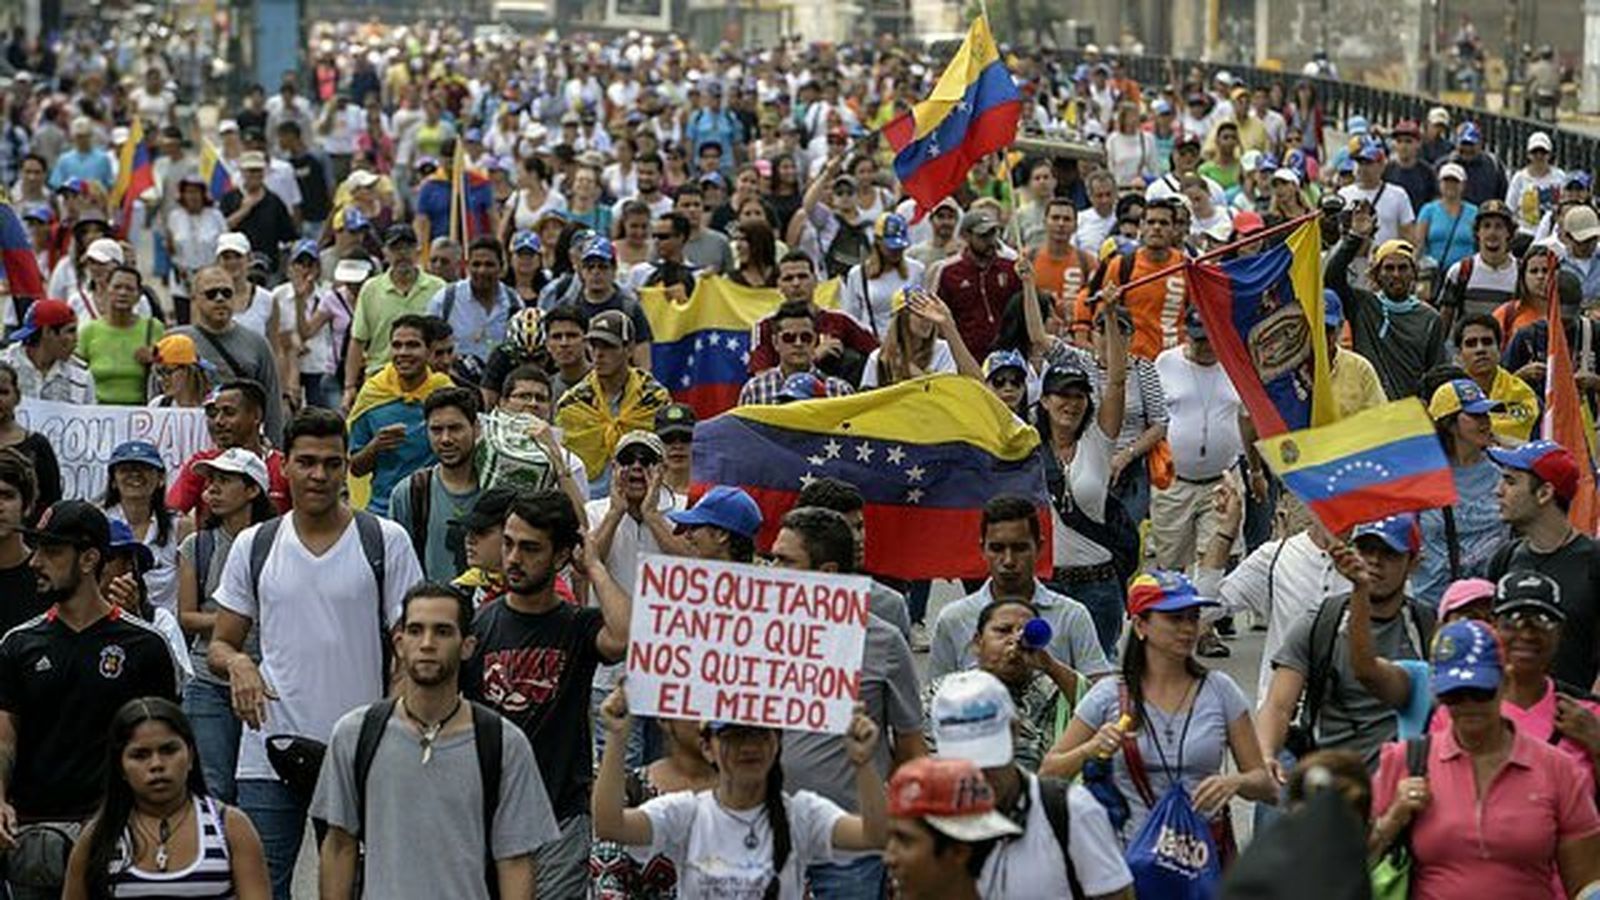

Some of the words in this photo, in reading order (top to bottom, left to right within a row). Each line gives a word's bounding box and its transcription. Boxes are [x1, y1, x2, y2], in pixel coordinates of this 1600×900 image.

[640, 562, 709, 605] NOS
[713, 571, 872, 629] QUITARON
[649, 604, 753, 647] TANTO
[764, 620, 827, 660] QUE
[629, 641, 691, 678] NOS
[700, 650, 861, 701] QUITARON
[658, 682, 700, 716] EL
